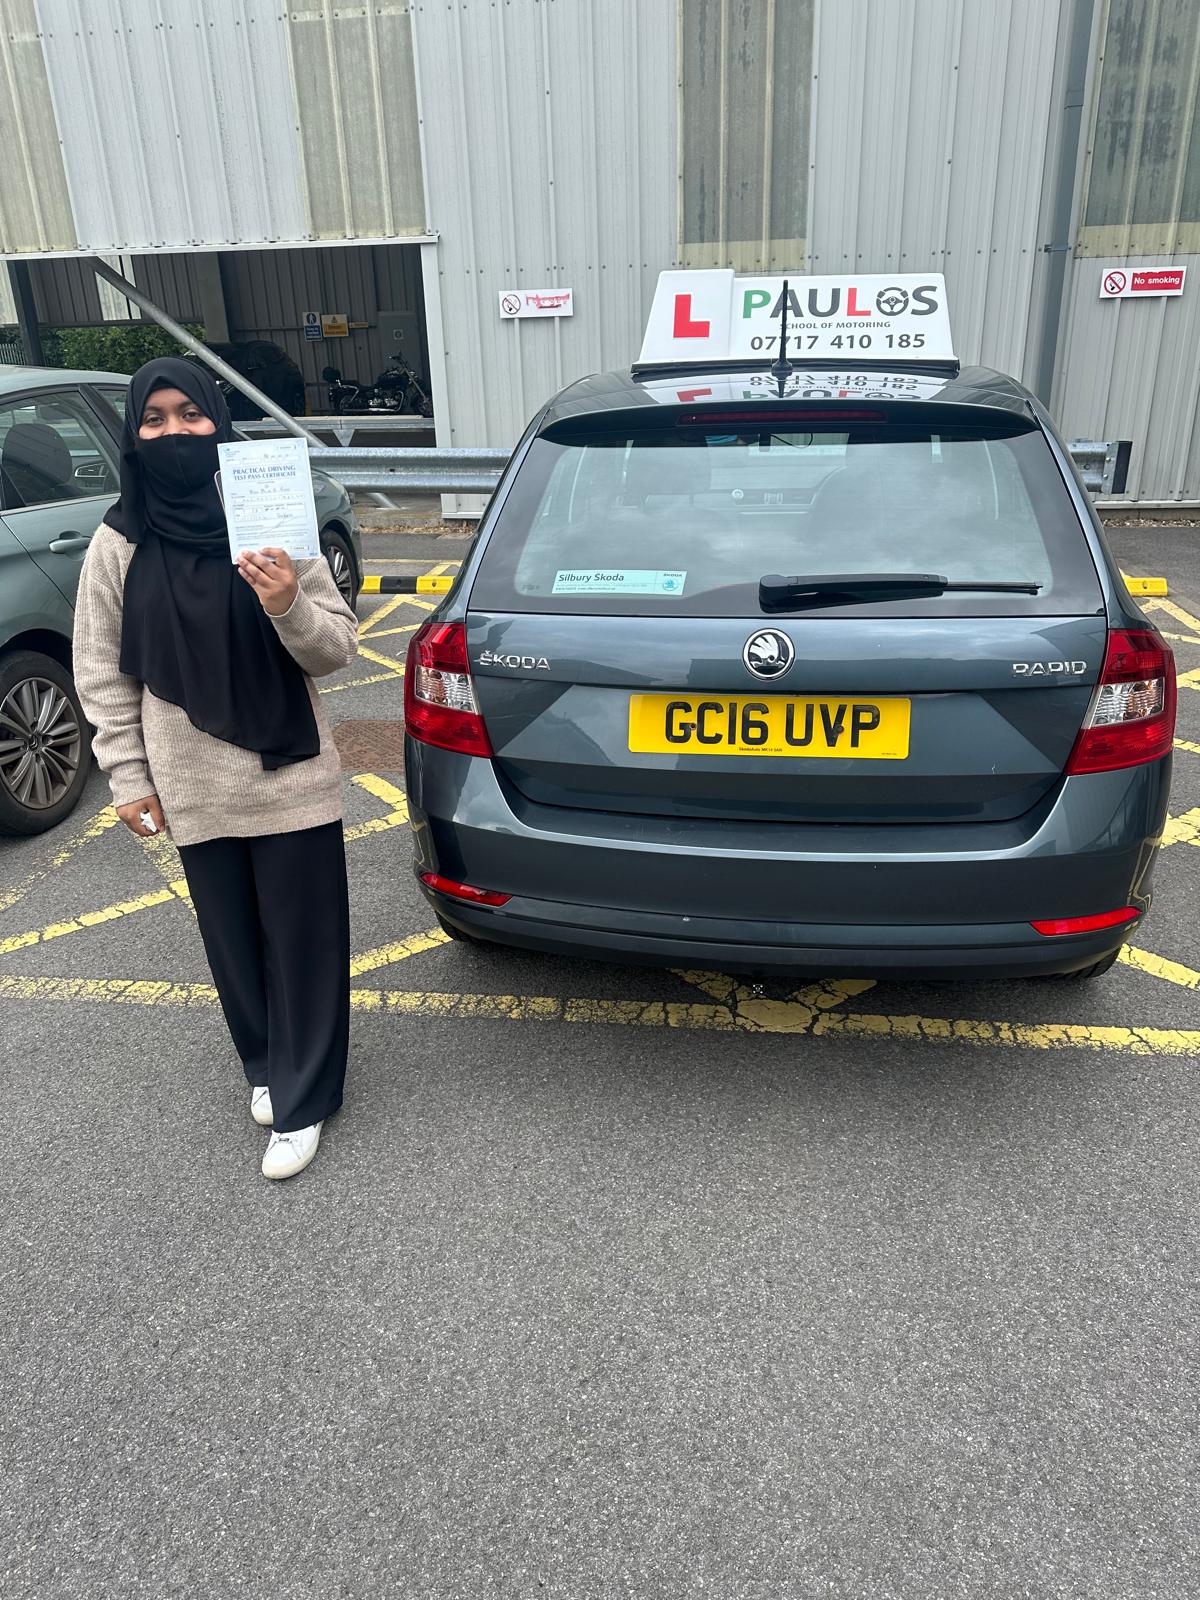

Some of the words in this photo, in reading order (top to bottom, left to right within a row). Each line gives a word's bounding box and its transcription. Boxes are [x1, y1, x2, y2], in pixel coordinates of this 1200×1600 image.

[1148, 276, 1180, 285] smoking
[673, 294, 710, 338] L
[836, 321, 891, 329] MOTORING
[750, 335, 819, 350] 07717
[830, 334, 872, 349] 410
[885, 333, 925, 348] 185
[558, 573, 592, 583] Silbury
[594, 573, 624, 581] Skoda
[1012, 661, 1087, 677] RAPID
[665, 701, 770, 746] GC16
[785, 703, 881, 748] UVP
